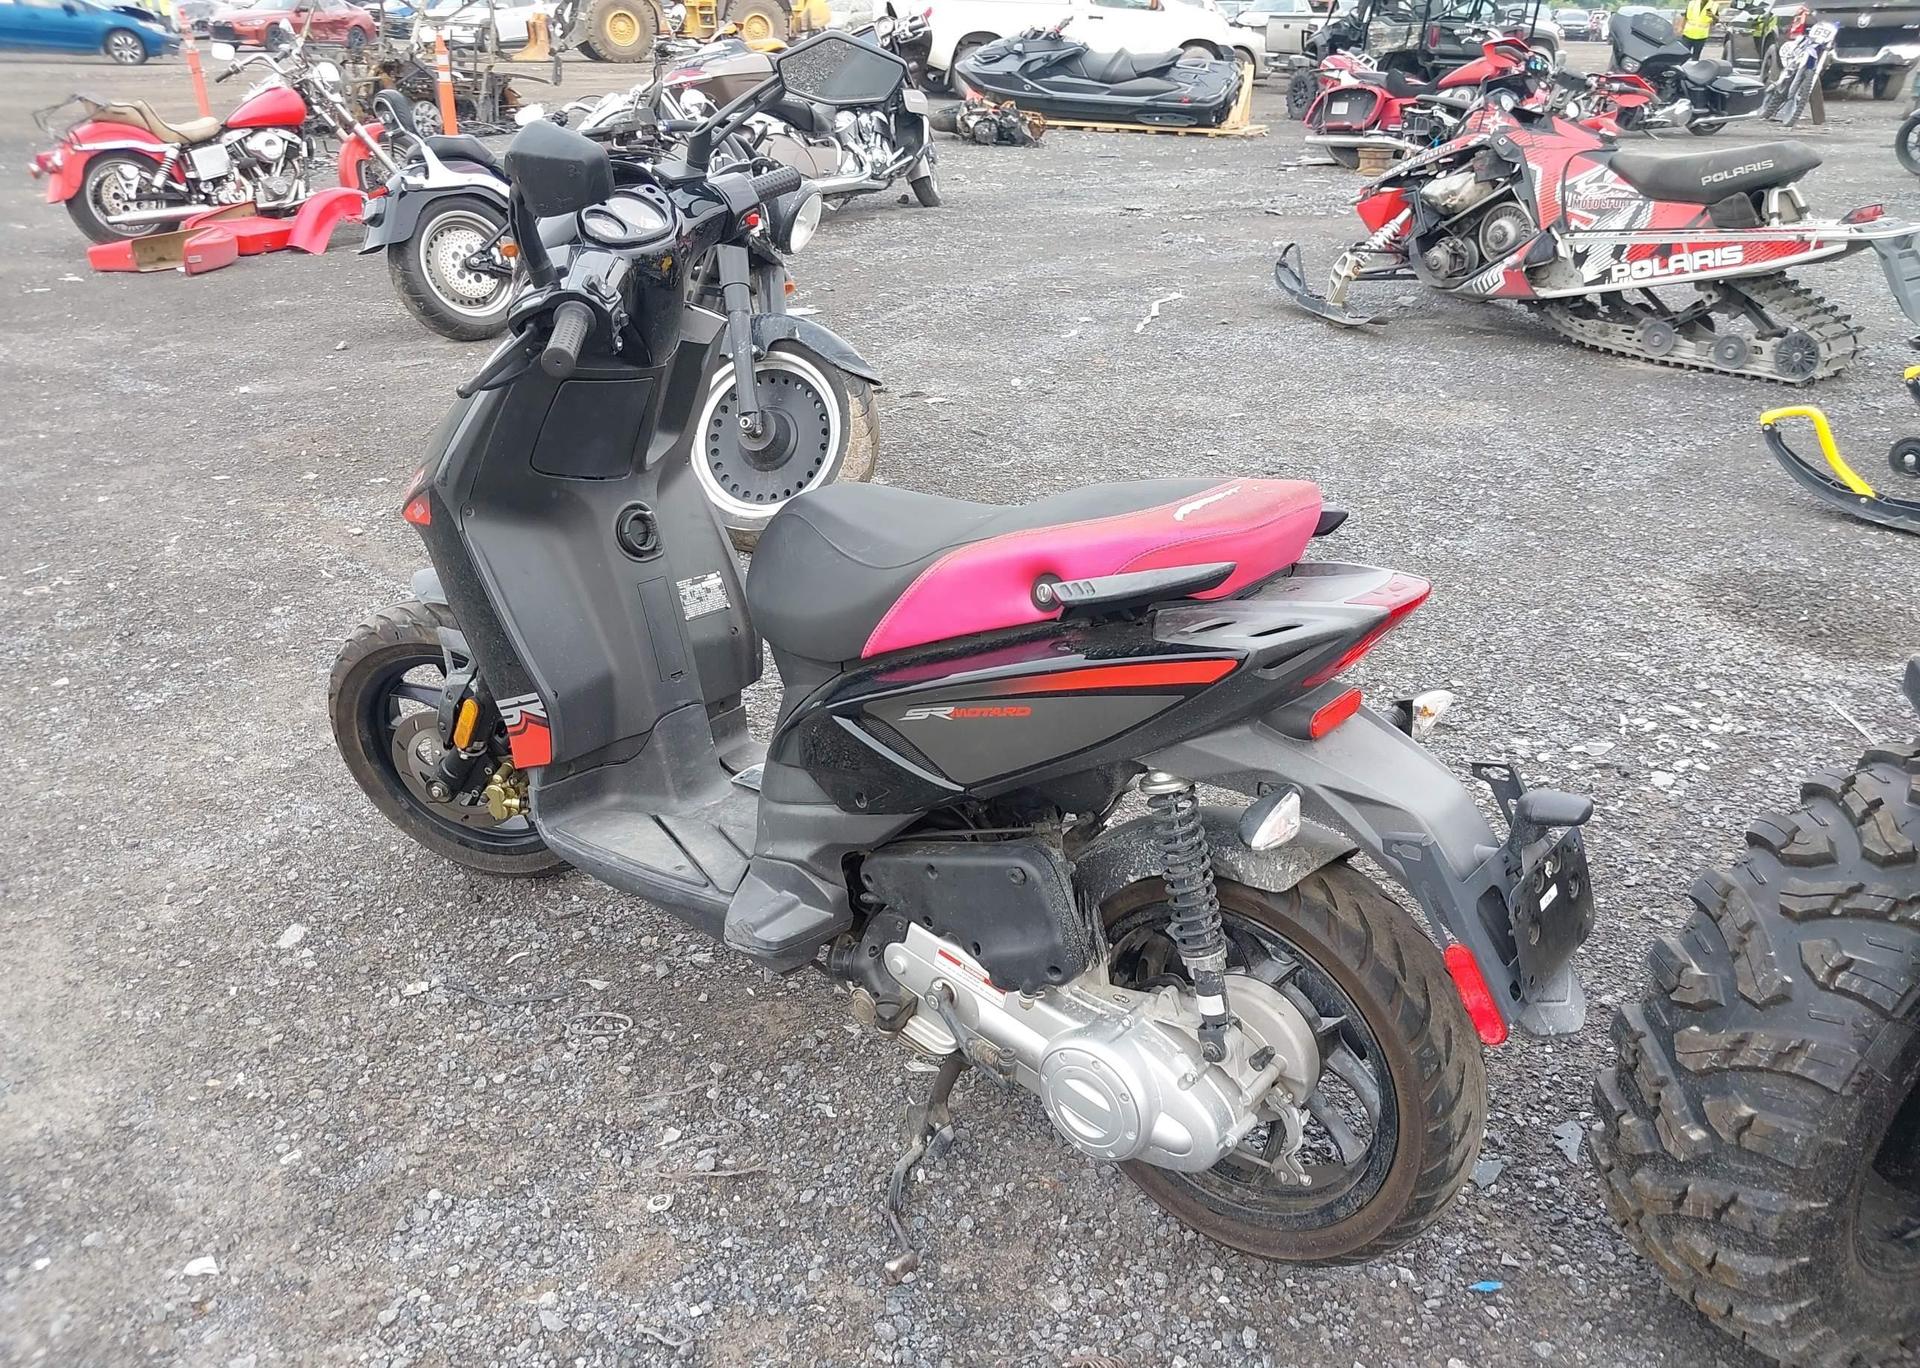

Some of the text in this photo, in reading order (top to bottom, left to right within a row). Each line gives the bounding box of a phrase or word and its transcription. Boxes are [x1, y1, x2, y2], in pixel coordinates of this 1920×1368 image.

[1701, 159, 1774, 186] POLARIS
[1610, 245, 1744, 282] POLARIS
[951, 706, 1032, 719] MOTARD
